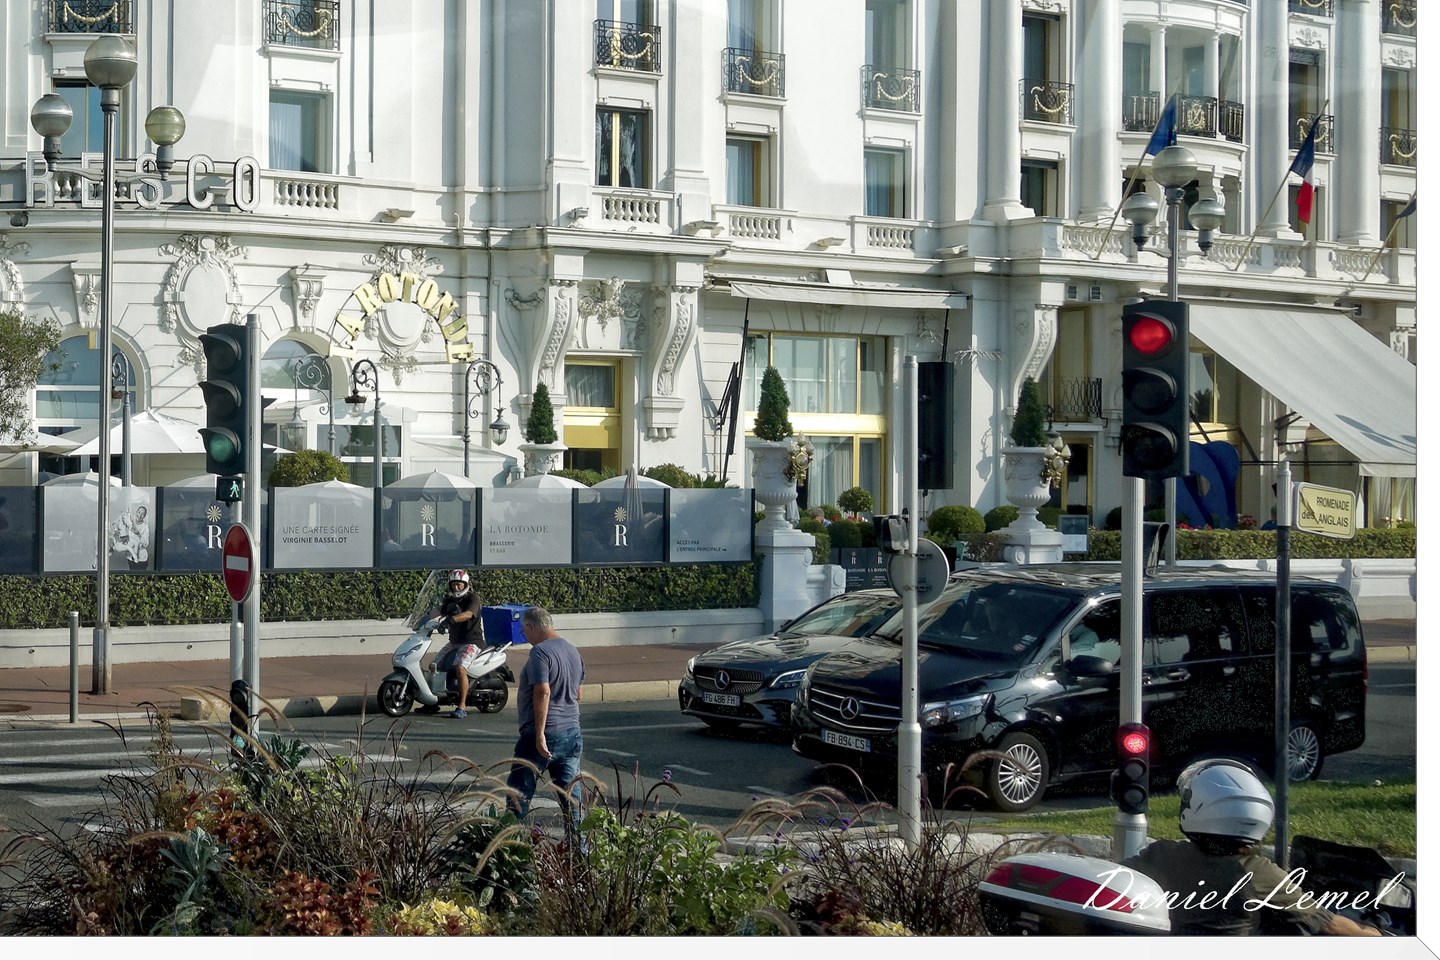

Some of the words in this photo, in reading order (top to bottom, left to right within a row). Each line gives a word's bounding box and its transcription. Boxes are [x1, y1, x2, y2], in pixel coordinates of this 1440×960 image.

[329, 313, 366, 360] LA
[353, 272, 474, 364] ROTONDE
[1316, 496, 1350, 512] PROMENADE
[1301, 510, 1315, 520] des
[1318, 513, 1349, 528] ANGLAIS
[282, 526, 300, 534] UNE
[302, 525, 328, 534] CARTE
[330, 524, 360, 534] SIGNÉE
[489, 525, 502, 534] LA
[505, 525, 549, 534] ROTONDE
[314, 536, 347, 544] BASSELOT
